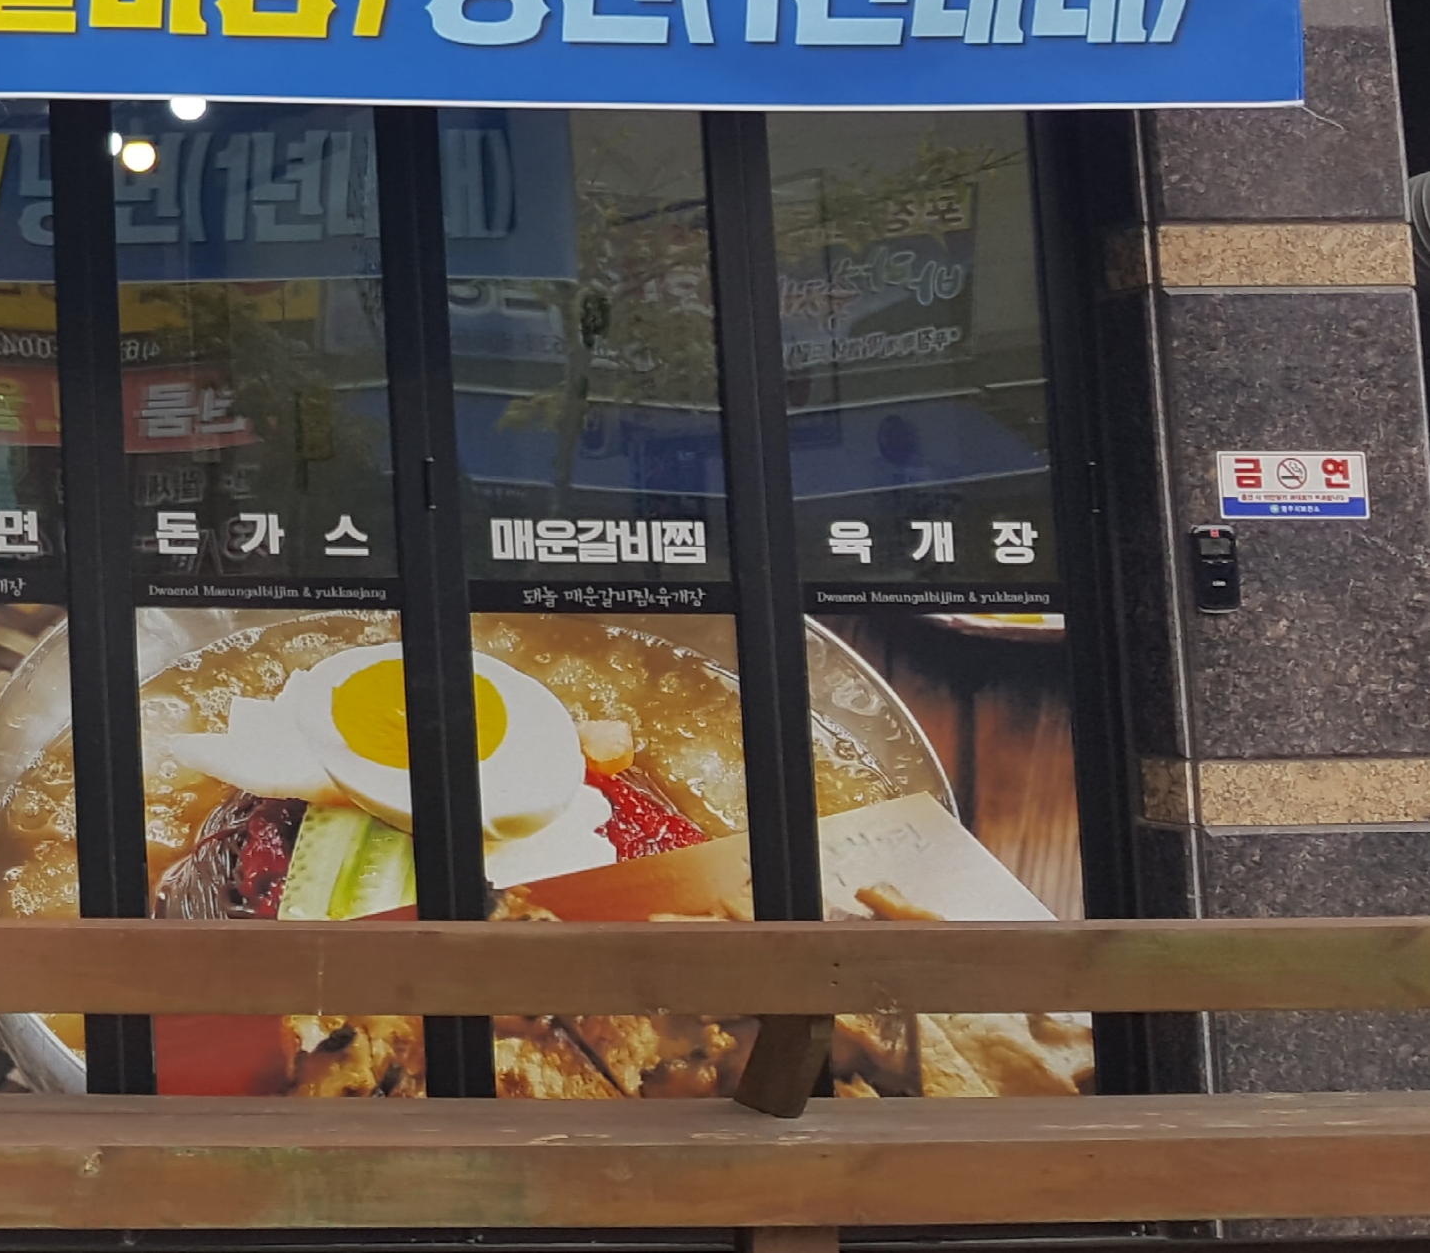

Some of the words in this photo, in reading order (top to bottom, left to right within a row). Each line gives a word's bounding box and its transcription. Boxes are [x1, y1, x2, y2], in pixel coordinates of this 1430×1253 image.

[491, 519, 706, 563] 매운갈비찜
[302, 586, 312, 598] &
[522, 586, 558, 607] 돼놀
[969, 592, 979, 604] &
